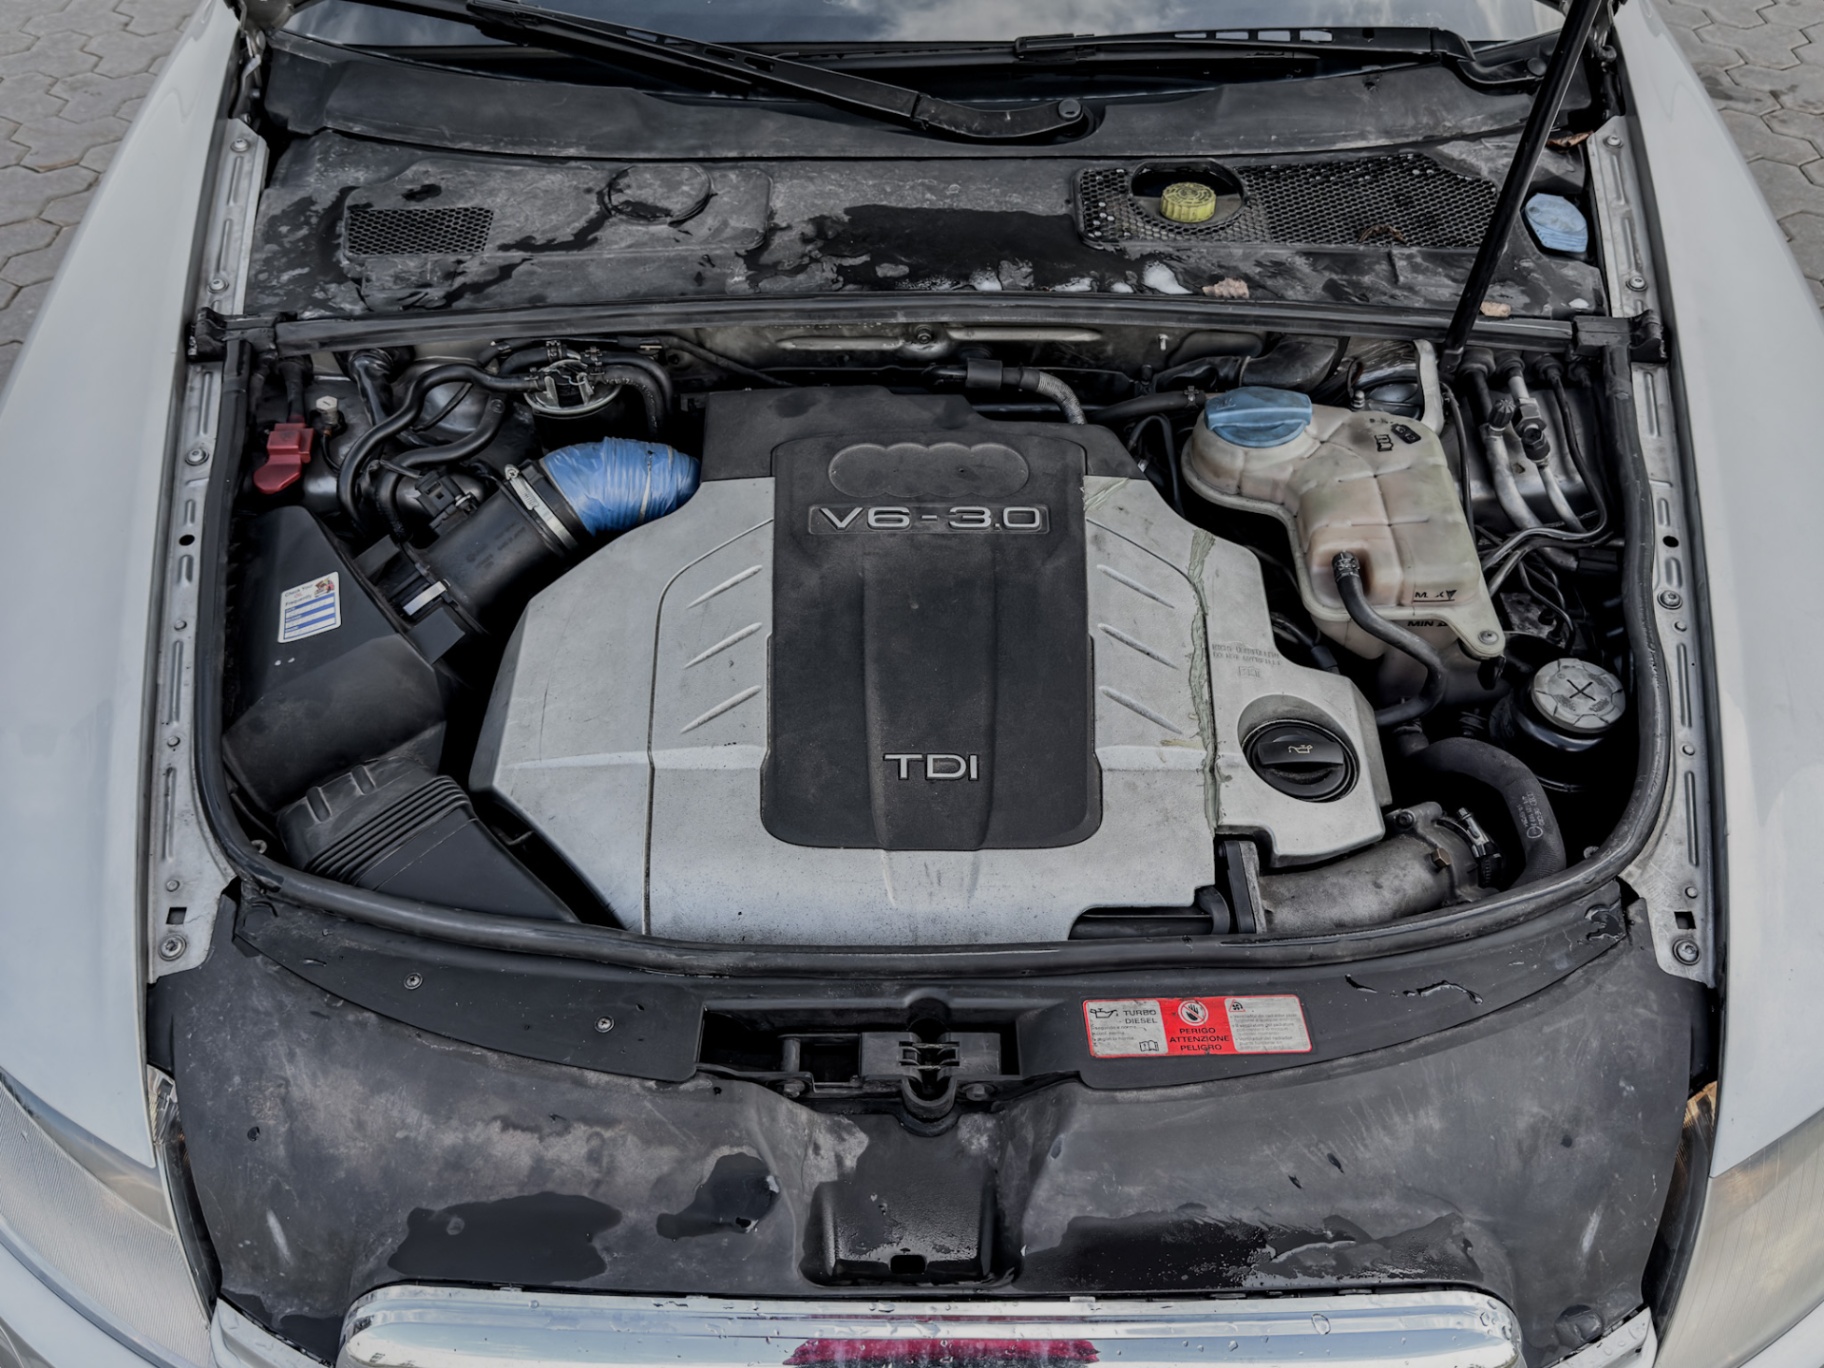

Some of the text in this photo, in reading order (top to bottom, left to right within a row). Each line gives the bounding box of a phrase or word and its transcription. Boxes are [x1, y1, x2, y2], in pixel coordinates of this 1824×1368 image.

[884, 754, 978, 780] TDI
[1123, 1009, 1156, 1017] TURBO
[1169, 1035, 1230, 1043] ATTENZIONE
